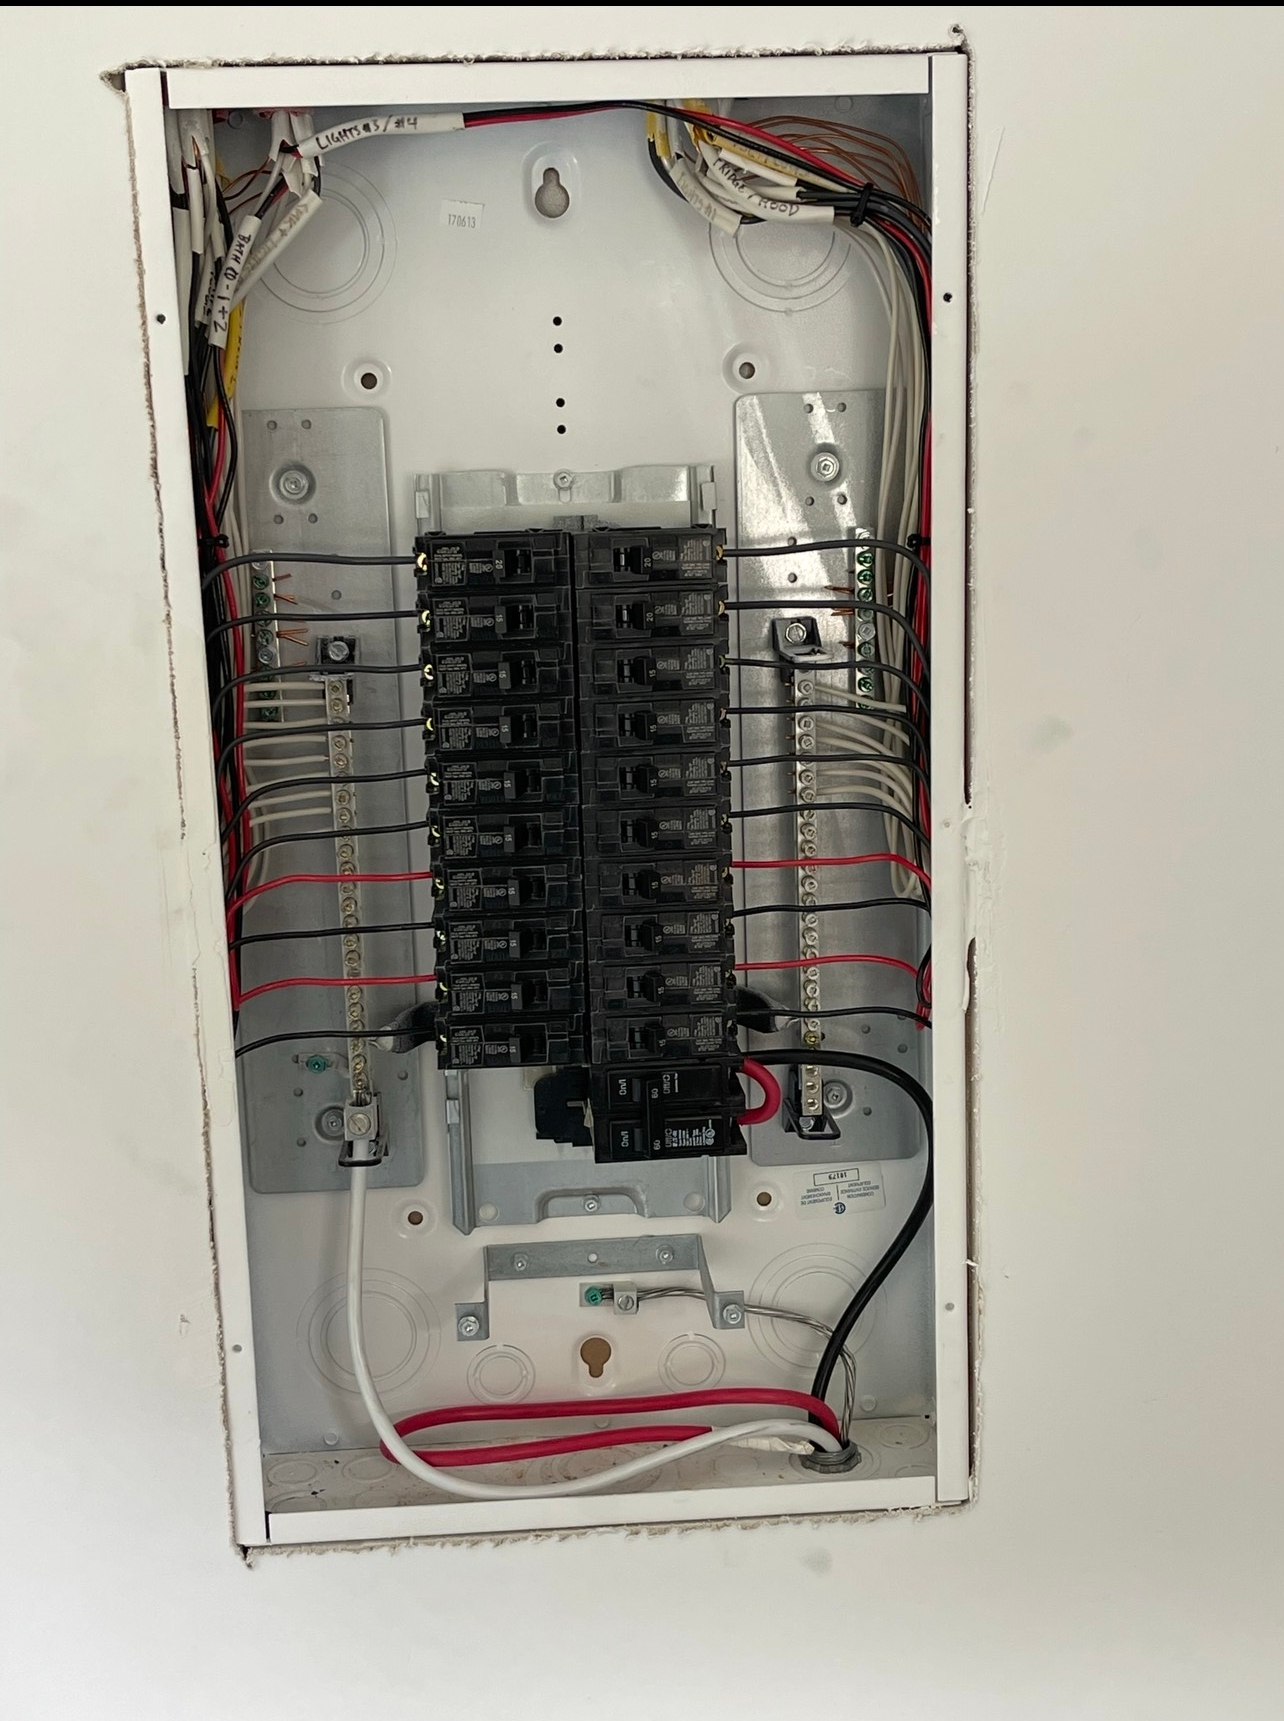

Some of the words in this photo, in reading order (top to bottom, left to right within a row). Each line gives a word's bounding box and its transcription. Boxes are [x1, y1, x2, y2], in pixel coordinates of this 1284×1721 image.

[315, 124, 361, 150] LIGHTS
[758, 197, 800, 217] HOOD
[447, 213, 477, 229] 170613
[230, 233, 252, 265] BATH
[494, 560, 504, 570] 20
[644, 558, 652, 568] 20
[496, 614, 504, 622] 15
[646, 612, 654, 622] 20
[498, 670, 506, 680] 15
[648, 668, 656, 678] 15
[502, 724, 508, 732] 15
[650, 724, 658, 732] 15
[504, 780, 512, 788] 15
[650, 778, 658, 786] 15
[504, 834, 512, 842] 15
[650, 830, 658, 840] 15
[652, 880, 658, 890] 15
[508, 886, 516, 896] 15
[510, 940, 516, 948] 15
[654, 934, 662, 944] 15
[658, 986, 666, 994] 15
[510, 992, 518, 1000] 15
[658, 1038, 666, 1048] 15
[651, 1088, 659, 1099] 60
[653, 1139, 661, 1151] 60
